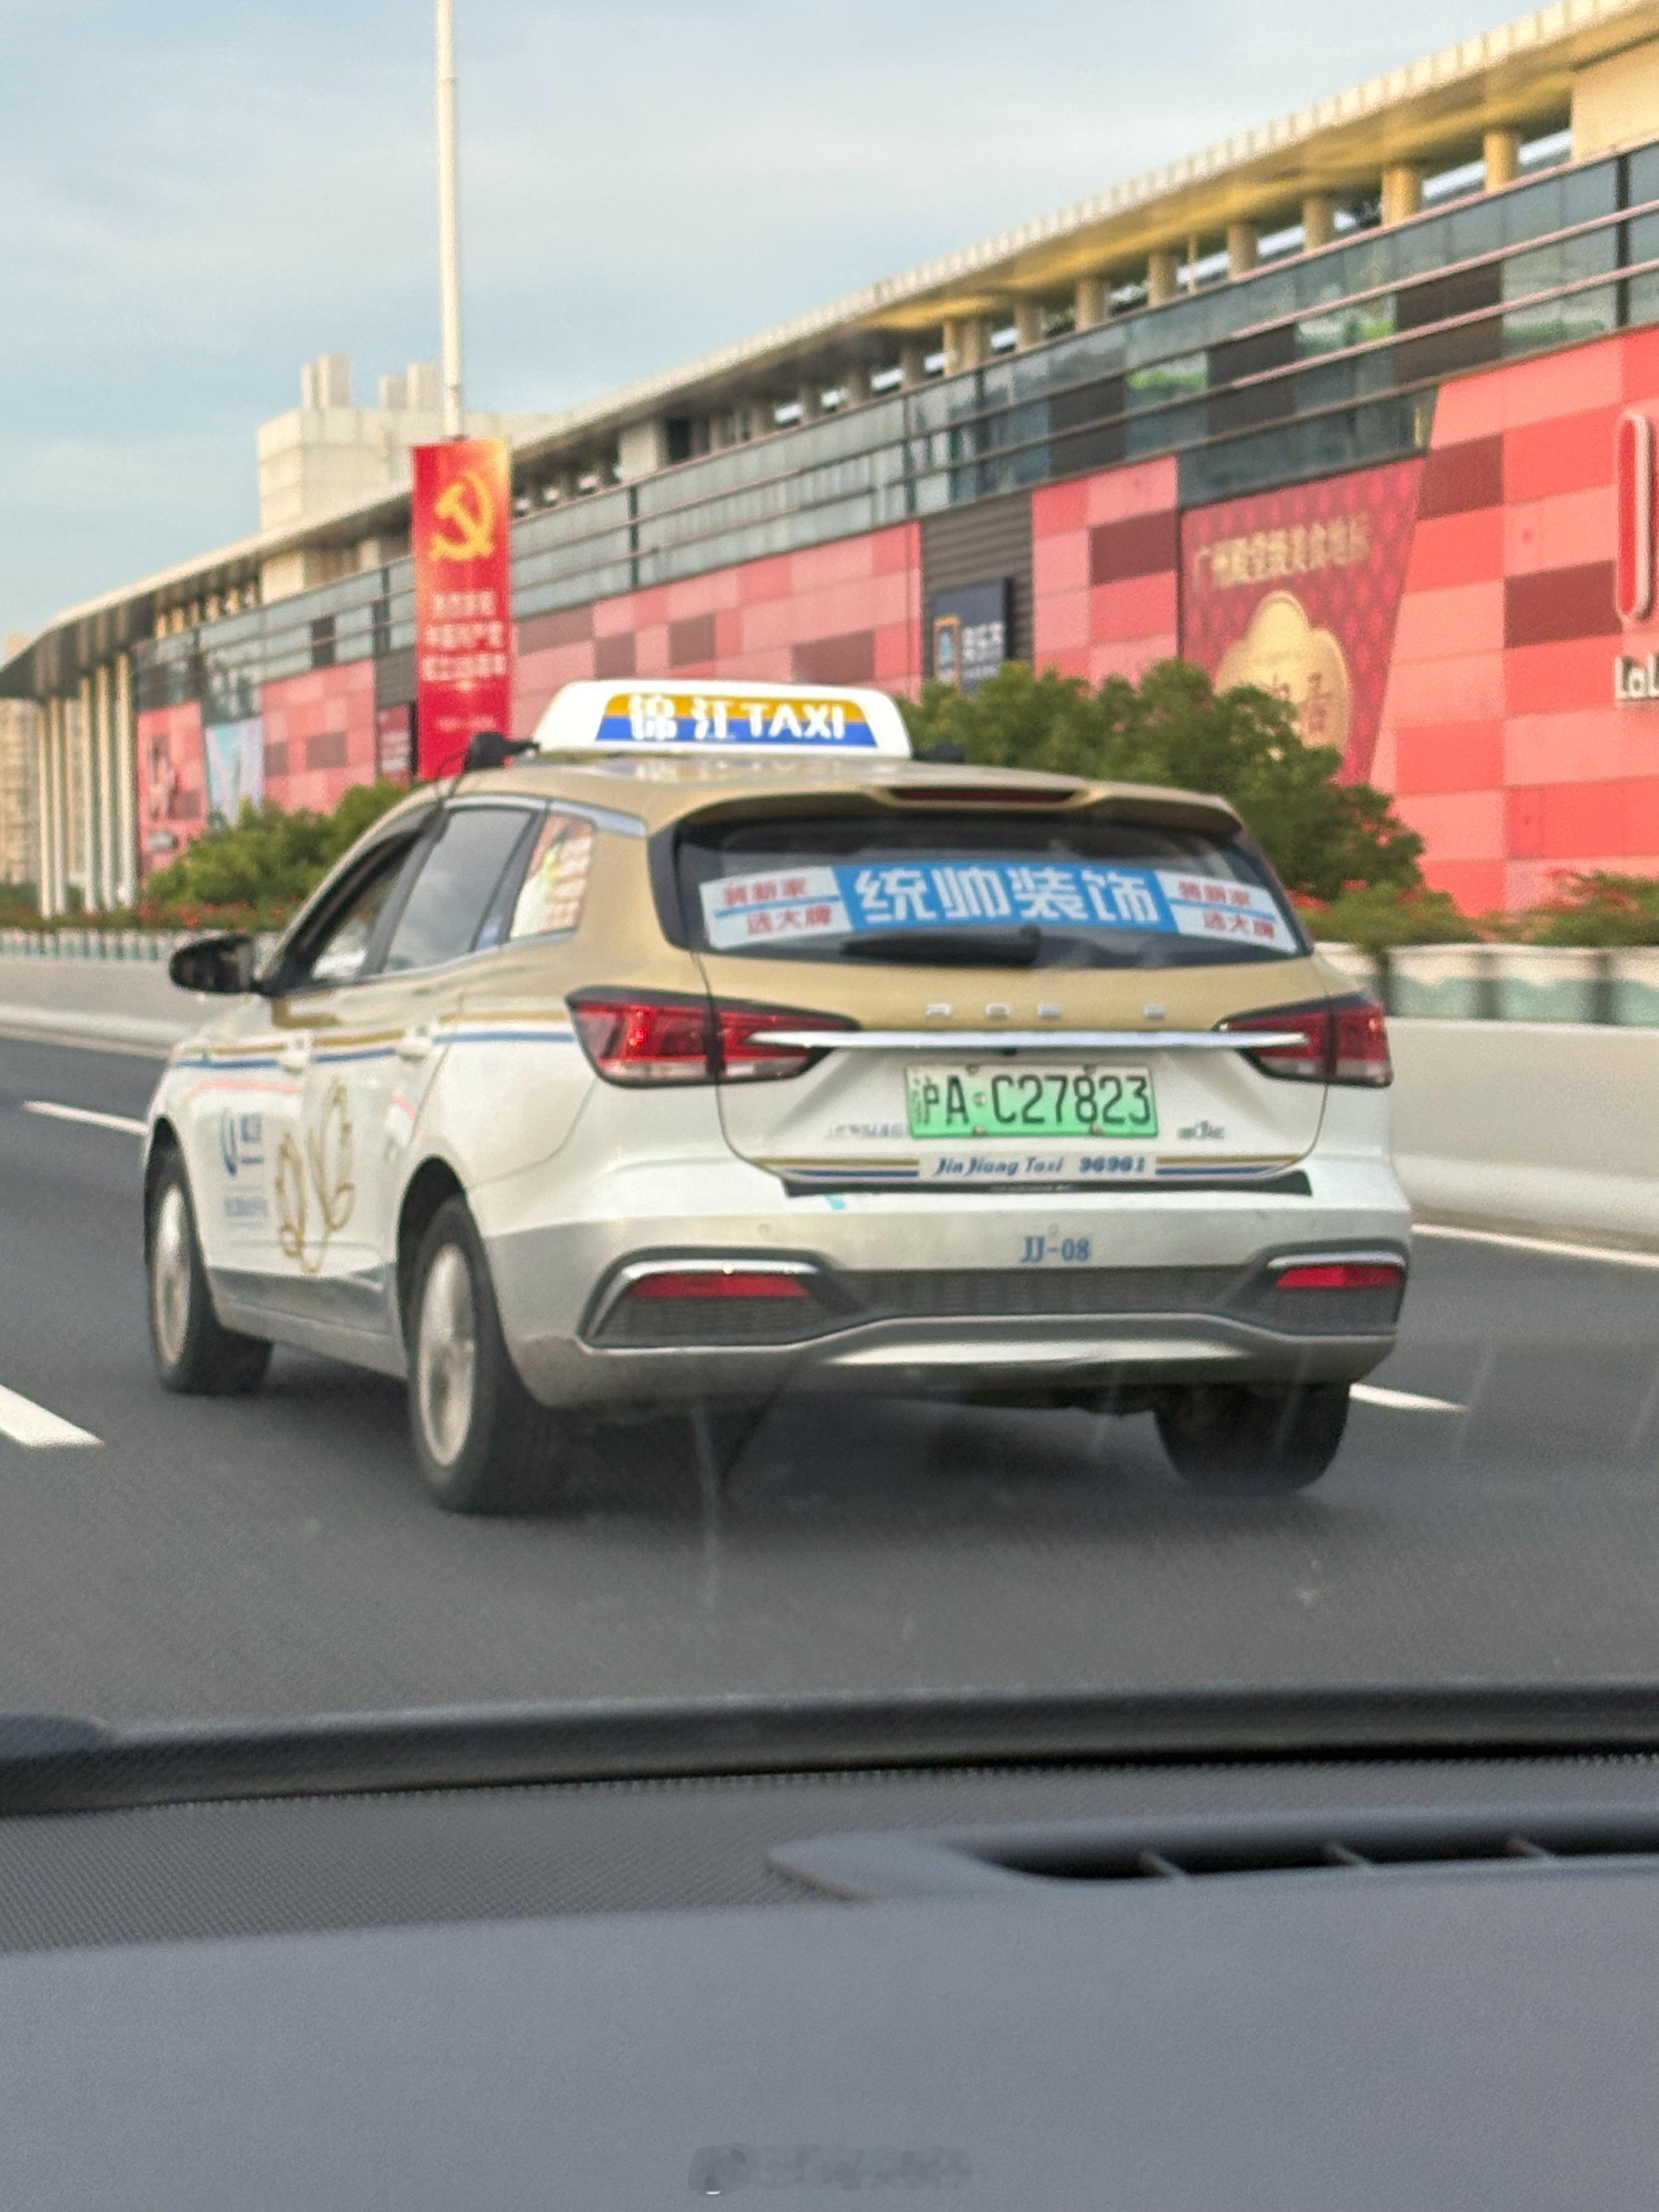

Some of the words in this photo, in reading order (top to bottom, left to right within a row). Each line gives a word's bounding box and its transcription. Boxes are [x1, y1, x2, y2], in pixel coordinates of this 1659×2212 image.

[740, 703, 846, 740] TAXI
[855, 866, 1159, 923] 统帅装饰
[935, 1157, 963, 1175] Jin
[966, 1157, 1019, 1176] Jiang
[1025, 1156, 1064, 1173] Taxi
[1020, 1235, 1090, 1263] JJ-08
